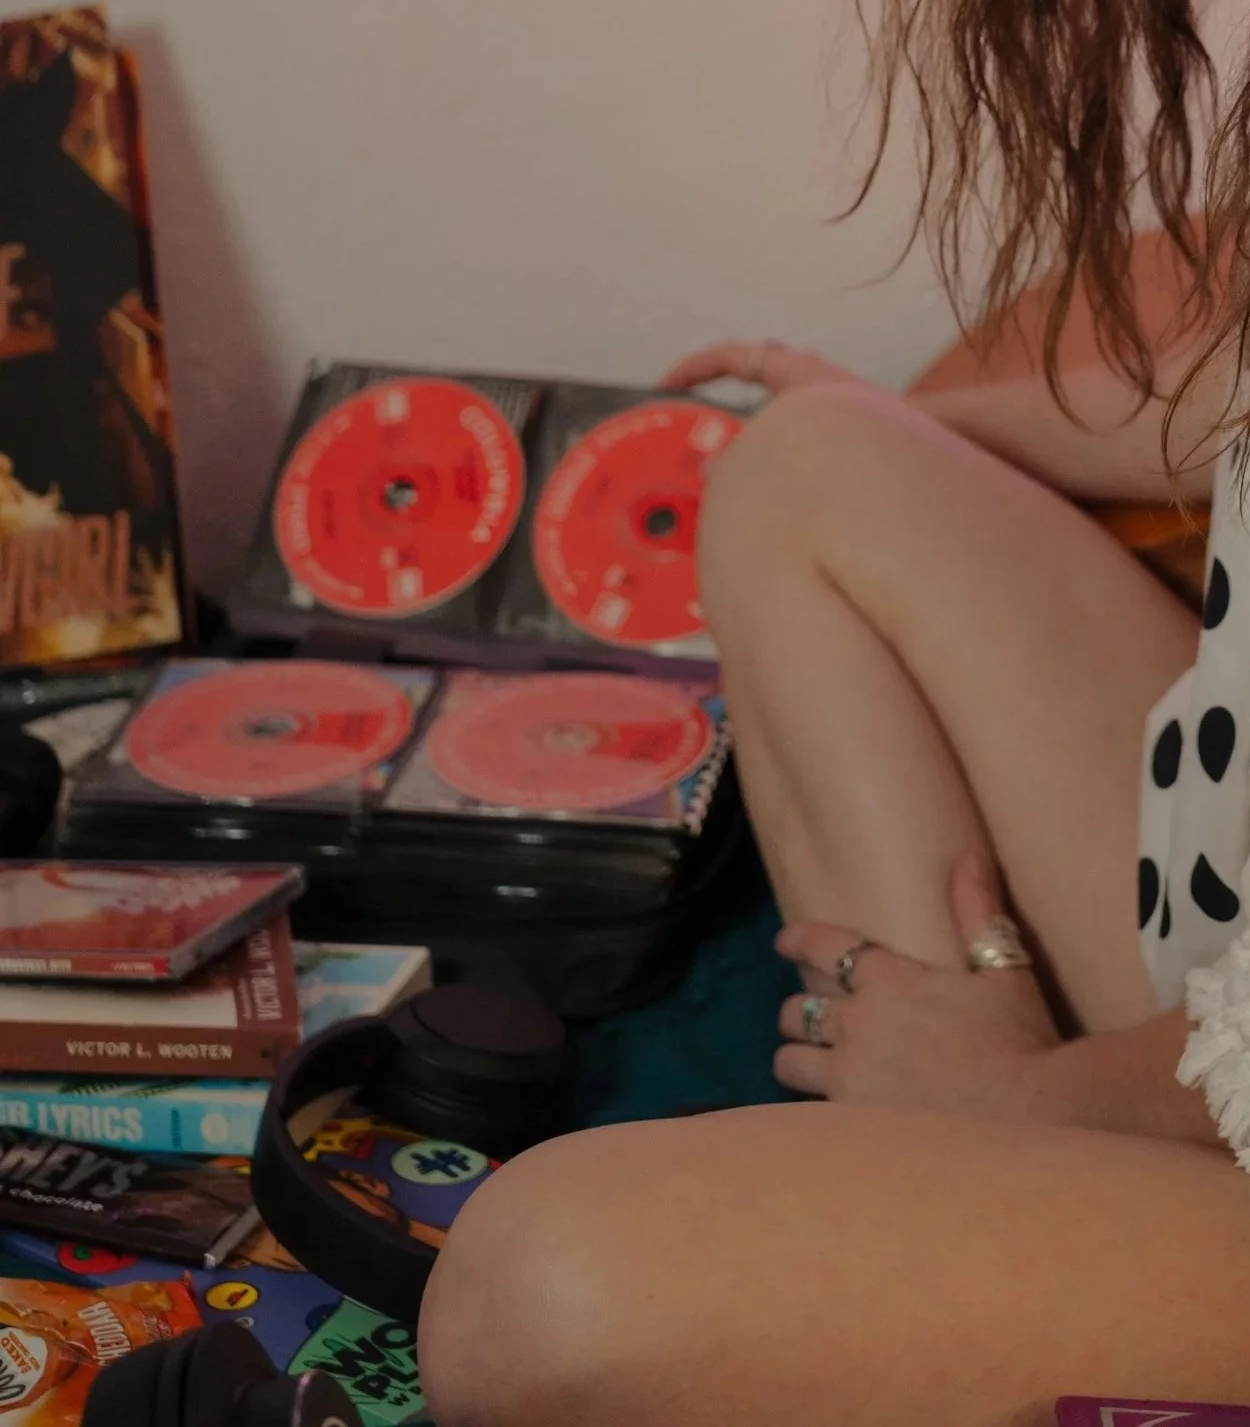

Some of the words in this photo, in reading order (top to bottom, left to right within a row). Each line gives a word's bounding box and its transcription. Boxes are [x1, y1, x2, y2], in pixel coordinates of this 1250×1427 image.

[65, 1040, 132, 1059] VICTOR
[136, 1041, 152, 1060] L.
[158, 1042, 233, 1061] WOOTEN
[36, 1100, 144, 1143] LYRICS
[8, 1188, 105, 1213] chocolate
[0, 1336, 32, 1374] BAKED
